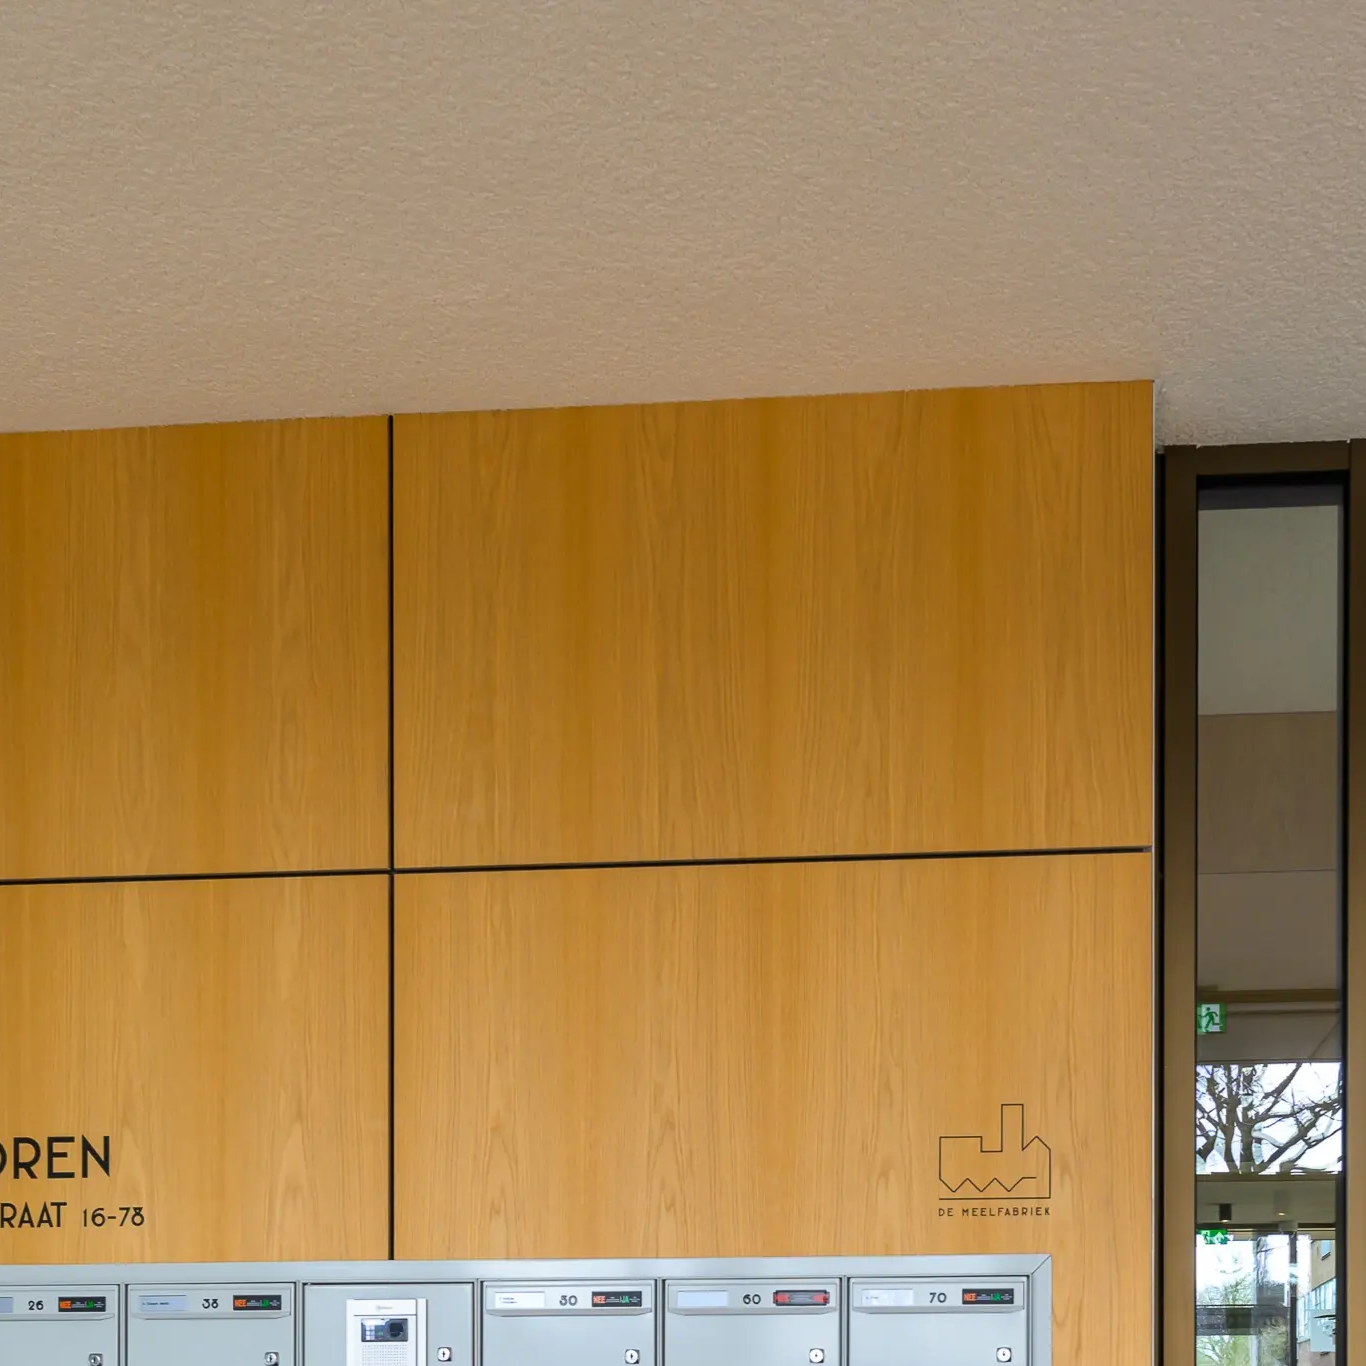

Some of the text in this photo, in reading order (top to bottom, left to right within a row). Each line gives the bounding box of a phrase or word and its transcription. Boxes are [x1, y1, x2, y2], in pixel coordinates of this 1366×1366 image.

[83, 1206, 145, 1228] 16-78
[938, 1206, 1050, 1217] DE MEELFABRIEK
[201, 1298, 219, 1310] 38
[559, 1294, 578, 1307] 50
[742, 1293, 762, 1305] 60
[929, 1292, 947, 1304] 70
[27, 1300, 44, 1311] 26
